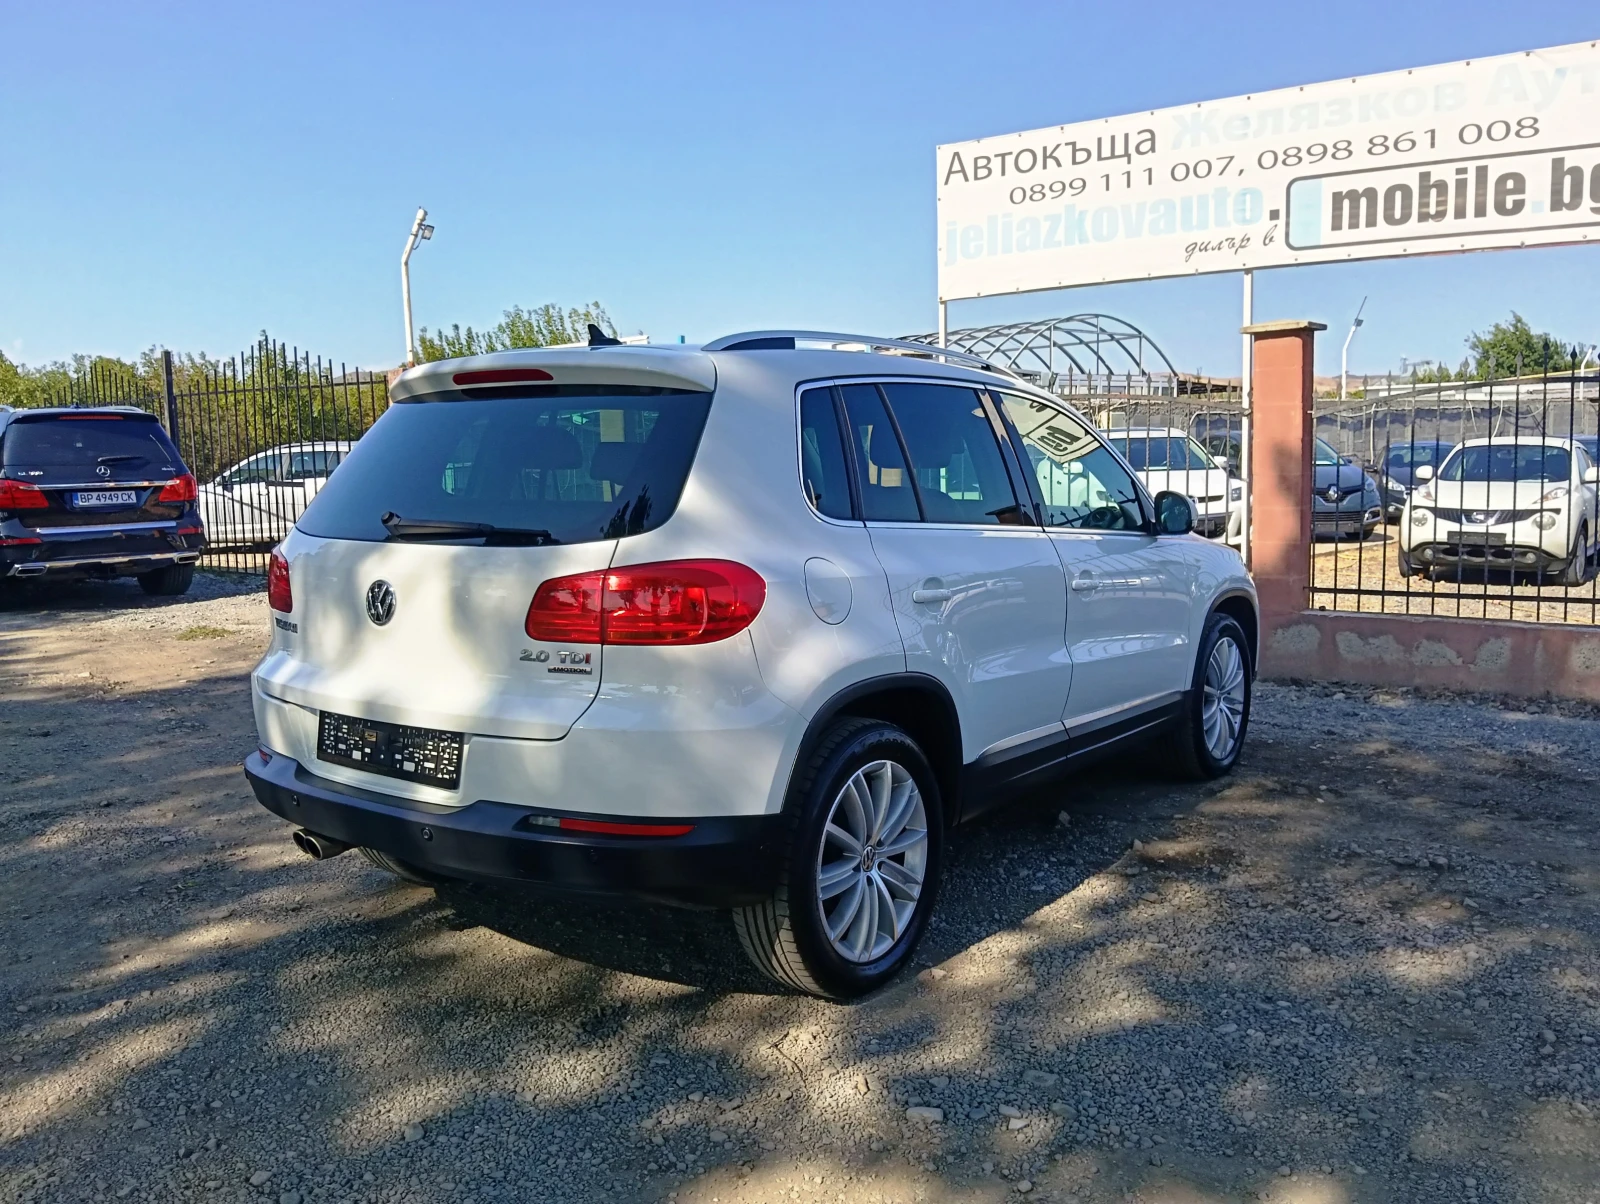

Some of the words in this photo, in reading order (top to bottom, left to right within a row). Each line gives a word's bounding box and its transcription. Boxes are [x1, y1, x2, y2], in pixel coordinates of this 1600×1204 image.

[944, 128, 1157, 185] Автокъща
[1171, 81, 1467, 150] Желязков
[1009, 177, 1087, 205] 0899
[1100, 167, 1153, 191] 111
[1170, 155, 1245, 182] 007,
[1257, 139, 1353, 169] 0898
[1367, 128, 1436, 156] 861
[1458, 116, 1540, 145] 008
[95, 492, 119, 502] 4949
[519, 648, 550, 663] 2.0
[557, 651, 591, 664] TDI
[551, 666, 587, 674] 4MOTION
